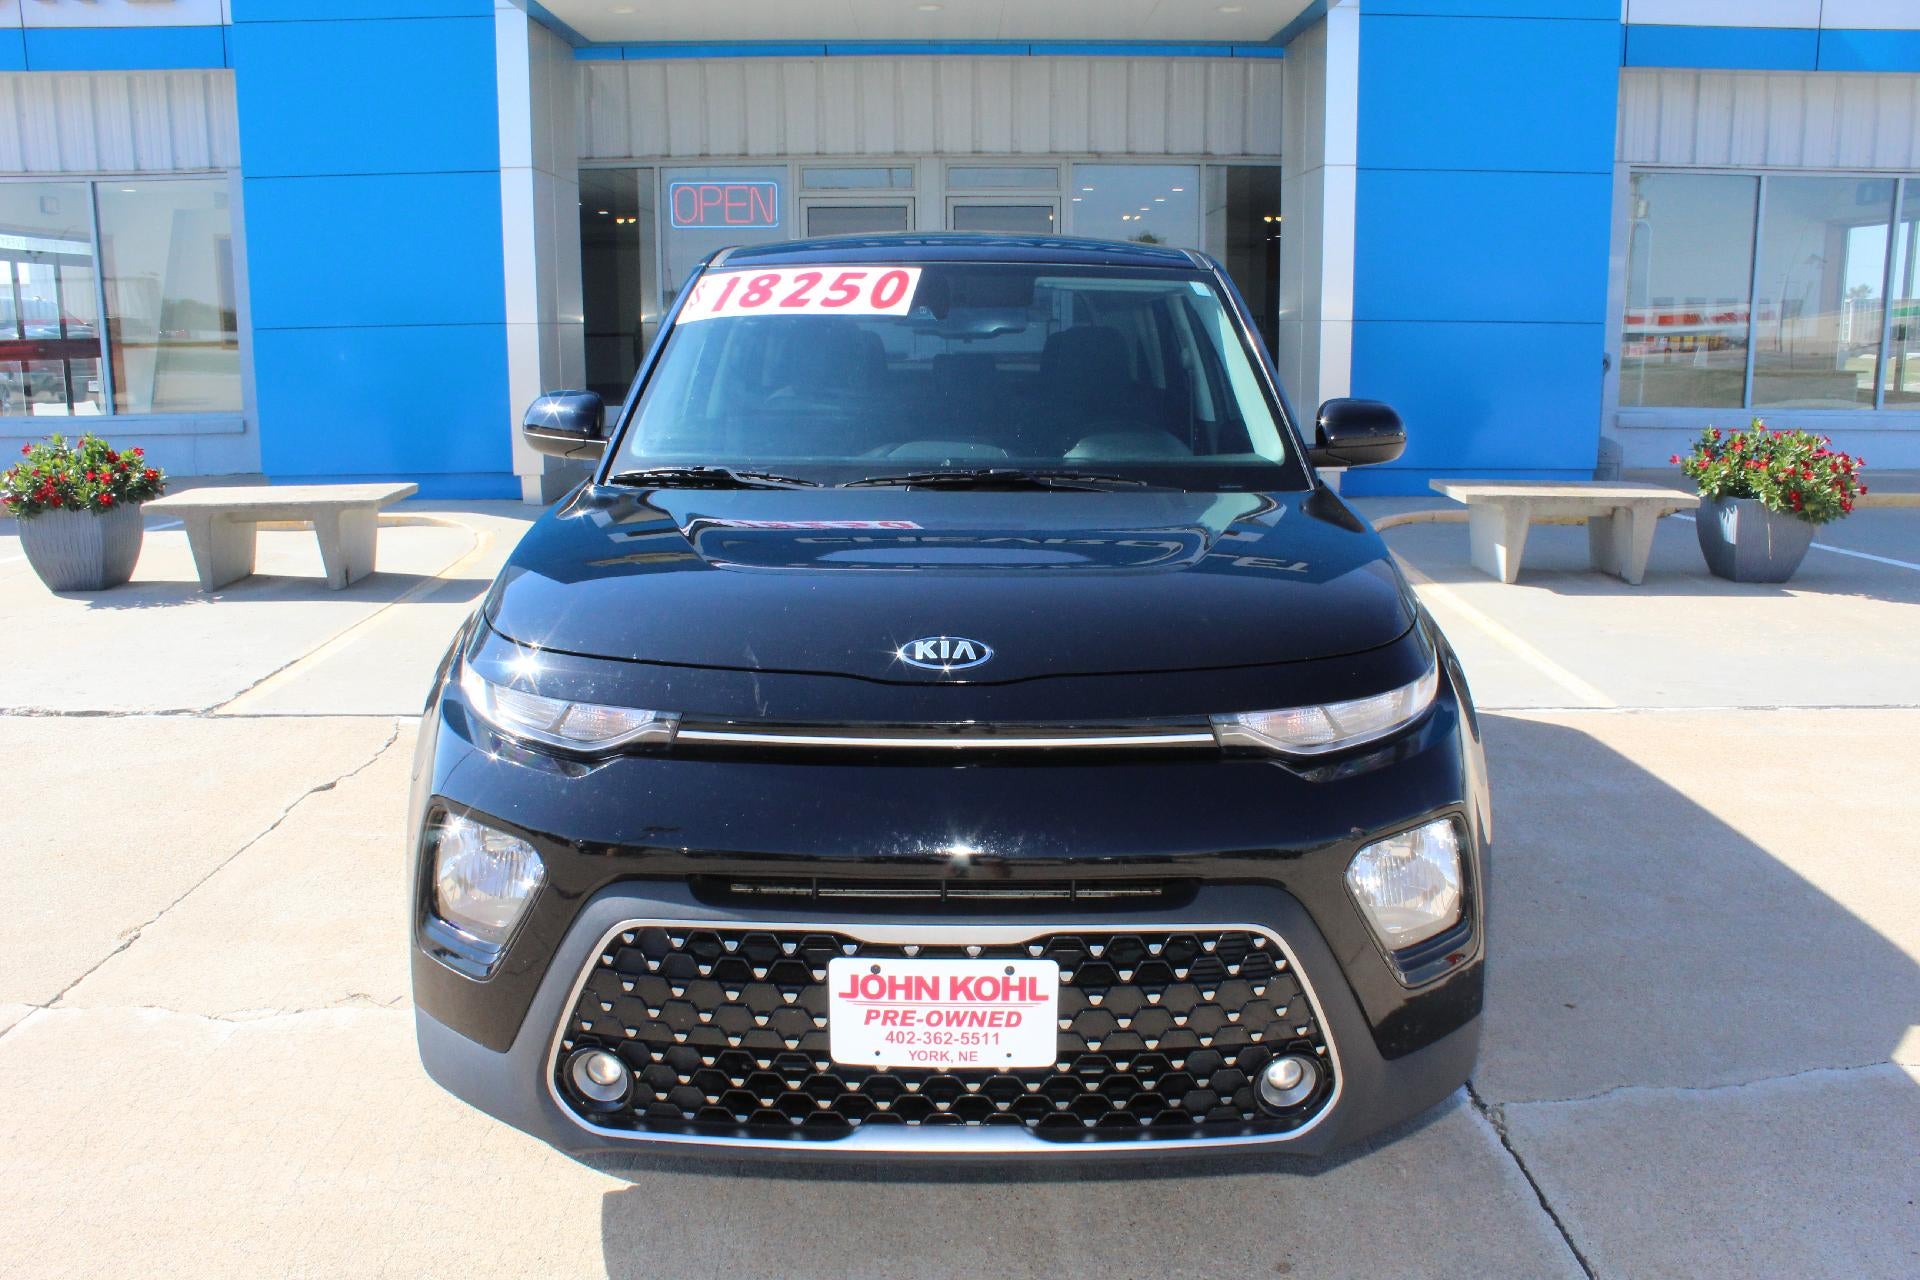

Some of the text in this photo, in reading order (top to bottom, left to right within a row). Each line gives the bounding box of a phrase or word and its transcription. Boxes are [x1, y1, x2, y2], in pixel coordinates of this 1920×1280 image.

[674, 185, 773, 224] OPEN
[915, 640, 977, 660] KIA
[838, 974, 1049, 1001] JOHN KOHL
[864, 1009, 1023, 1028] PRE-OWNED
[885, 1031, 1000, 1045] 402-362-5511
[909, 1050, 978, 1063] YORK, NE
